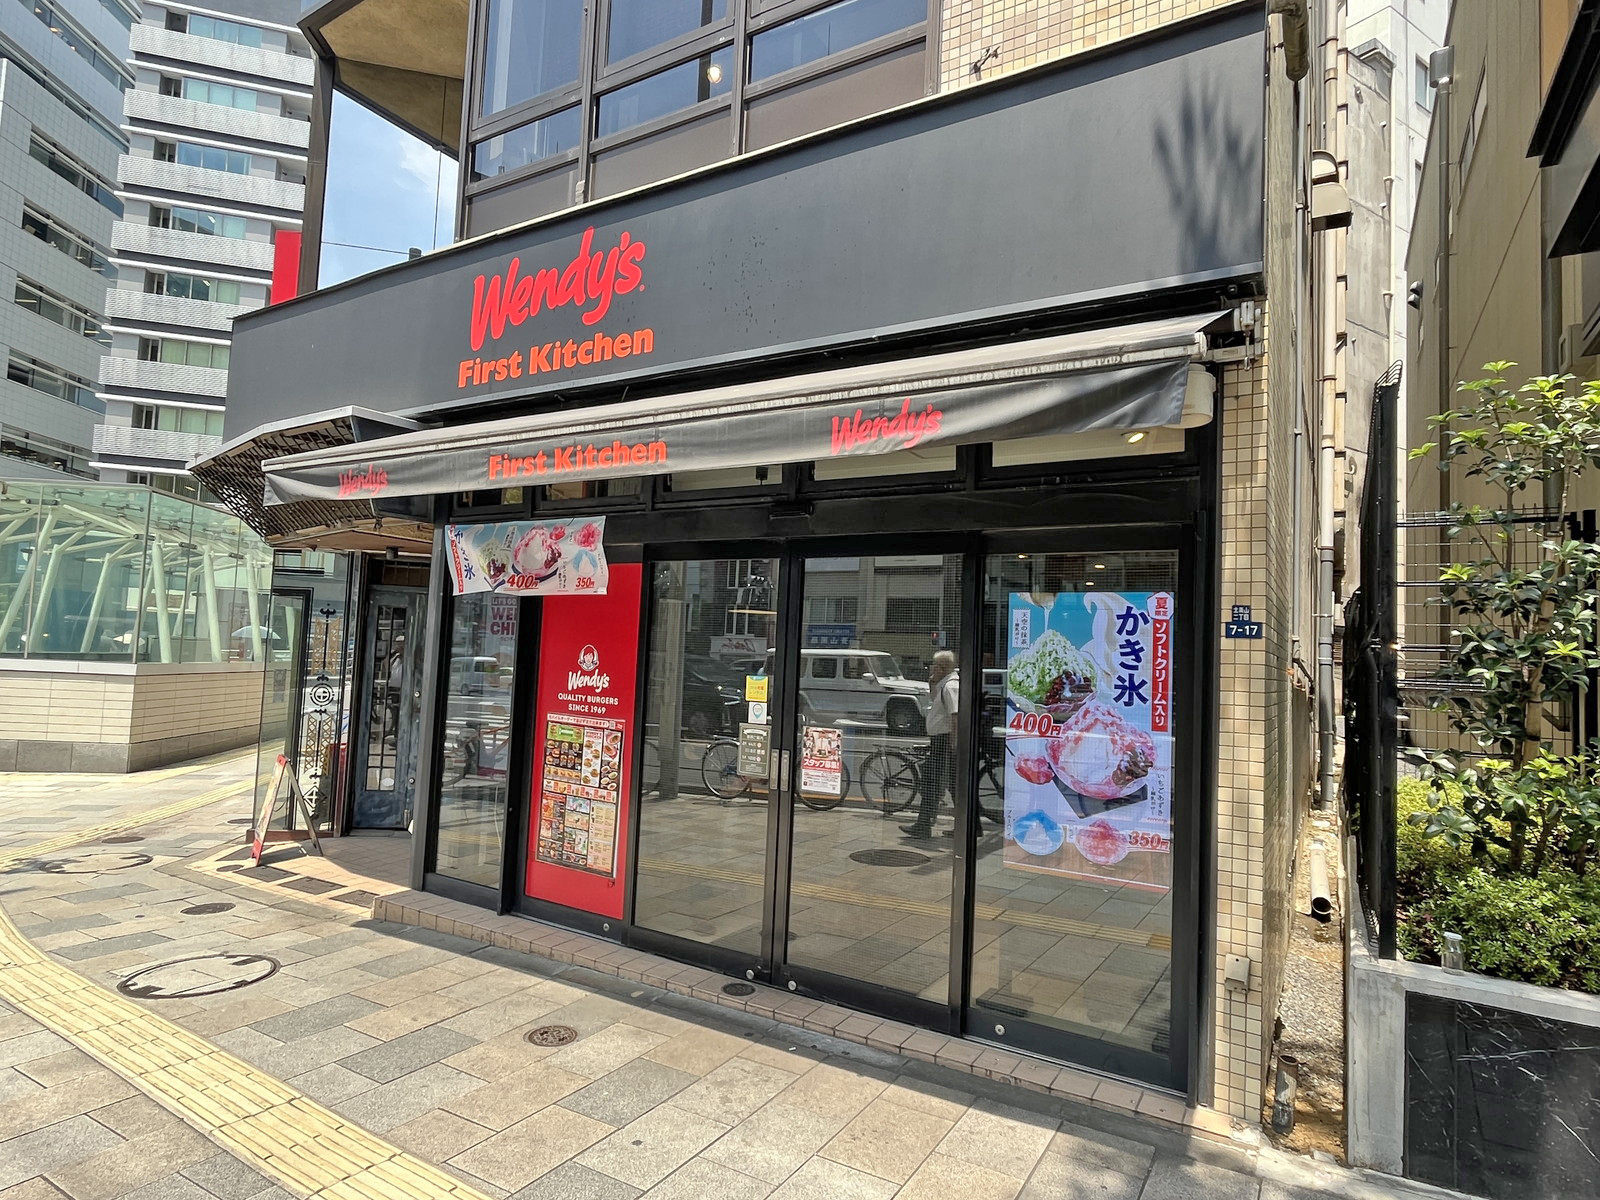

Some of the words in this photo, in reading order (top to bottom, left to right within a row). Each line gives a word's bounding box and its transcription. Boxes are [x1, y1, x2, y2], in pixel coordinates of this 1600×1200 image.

[470, 226, 646, 351] Wendy's
[458, 351, 523, 388] First
[528, 328, 654, 375] Kitchen
[831, 397, 943, 456] Wendy's
[488, 450, 548, 480] First
[553, 440, 668, 473] Kitchen
[337, 463, 389, 498] Wendy's
[1155, 597, 1168, 609] 夏
[1229, 625, 1258, 635] 7-17
[1113, 605, 1150, 707] かき氷
[568, 669, 610, 693] Wendy's
[1154, 621, 1168, 726] ソフトクリーム入り
[558, 692, 586, 702] QUALITY
[587, 695, 619, 705] BURGERS
[568, 703, 589, 712] SINCE
[590, 705, 606, 714] 1969
[1009, 712, 1063, 737] 400円
[1129, 831, 1169, 850] 350円
